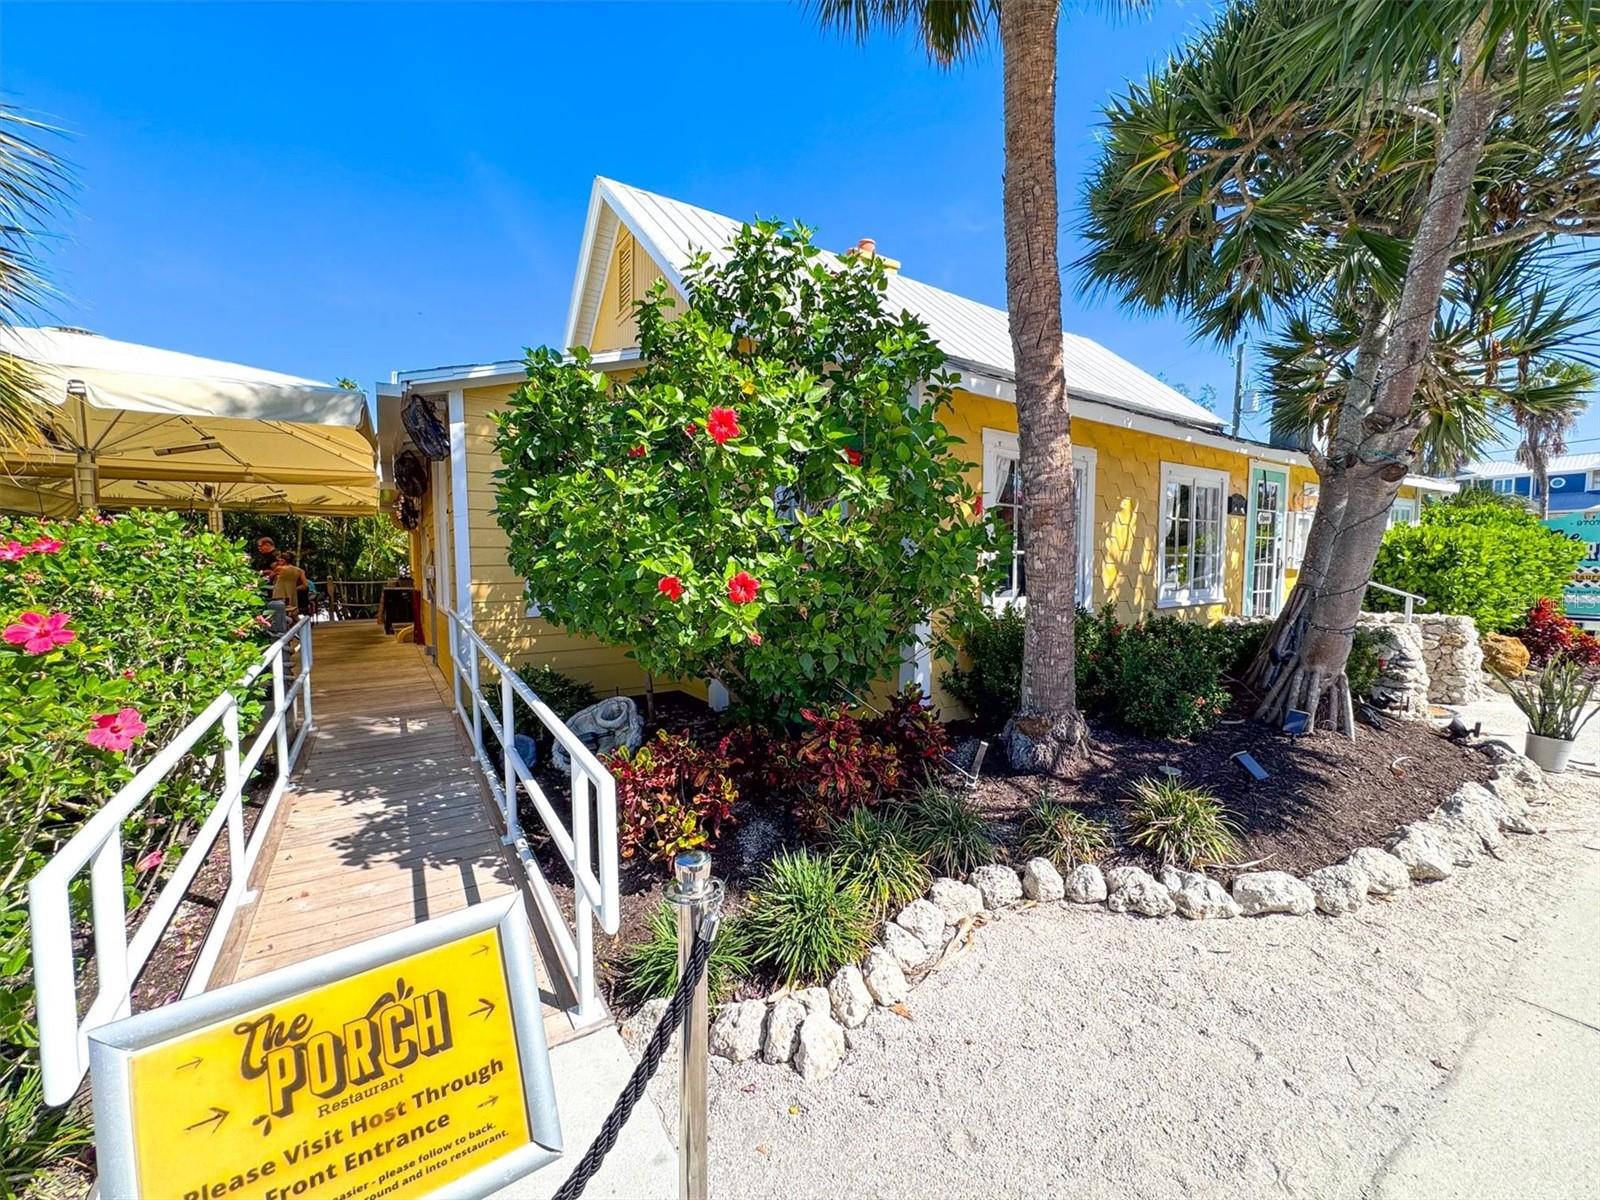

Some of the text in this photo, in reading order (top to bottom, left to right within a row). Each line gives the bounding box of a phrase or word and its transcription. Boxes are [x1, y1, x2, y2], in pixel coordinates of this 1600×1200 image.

[234, 1013, 313, 1080] The
[266, 989, 453, 1118] PORCH
[184, 1058, 504, 1200] Please Visit Host Through
[317, 1073, 405, 1118] Restaurant
[265, 1113, 451, 1200] Front Entrance
[378, 1160, 416, 1185] please
[417, 1143, 453, 1164] follow
[454, 1136, 467, 1147] to
[468, 1122, 497, 1140] back.
[402, 1168, 424, 1186] and
[425, 1159, 449, 1175] into
[449, 1129, 510, 1163] restaurant.
